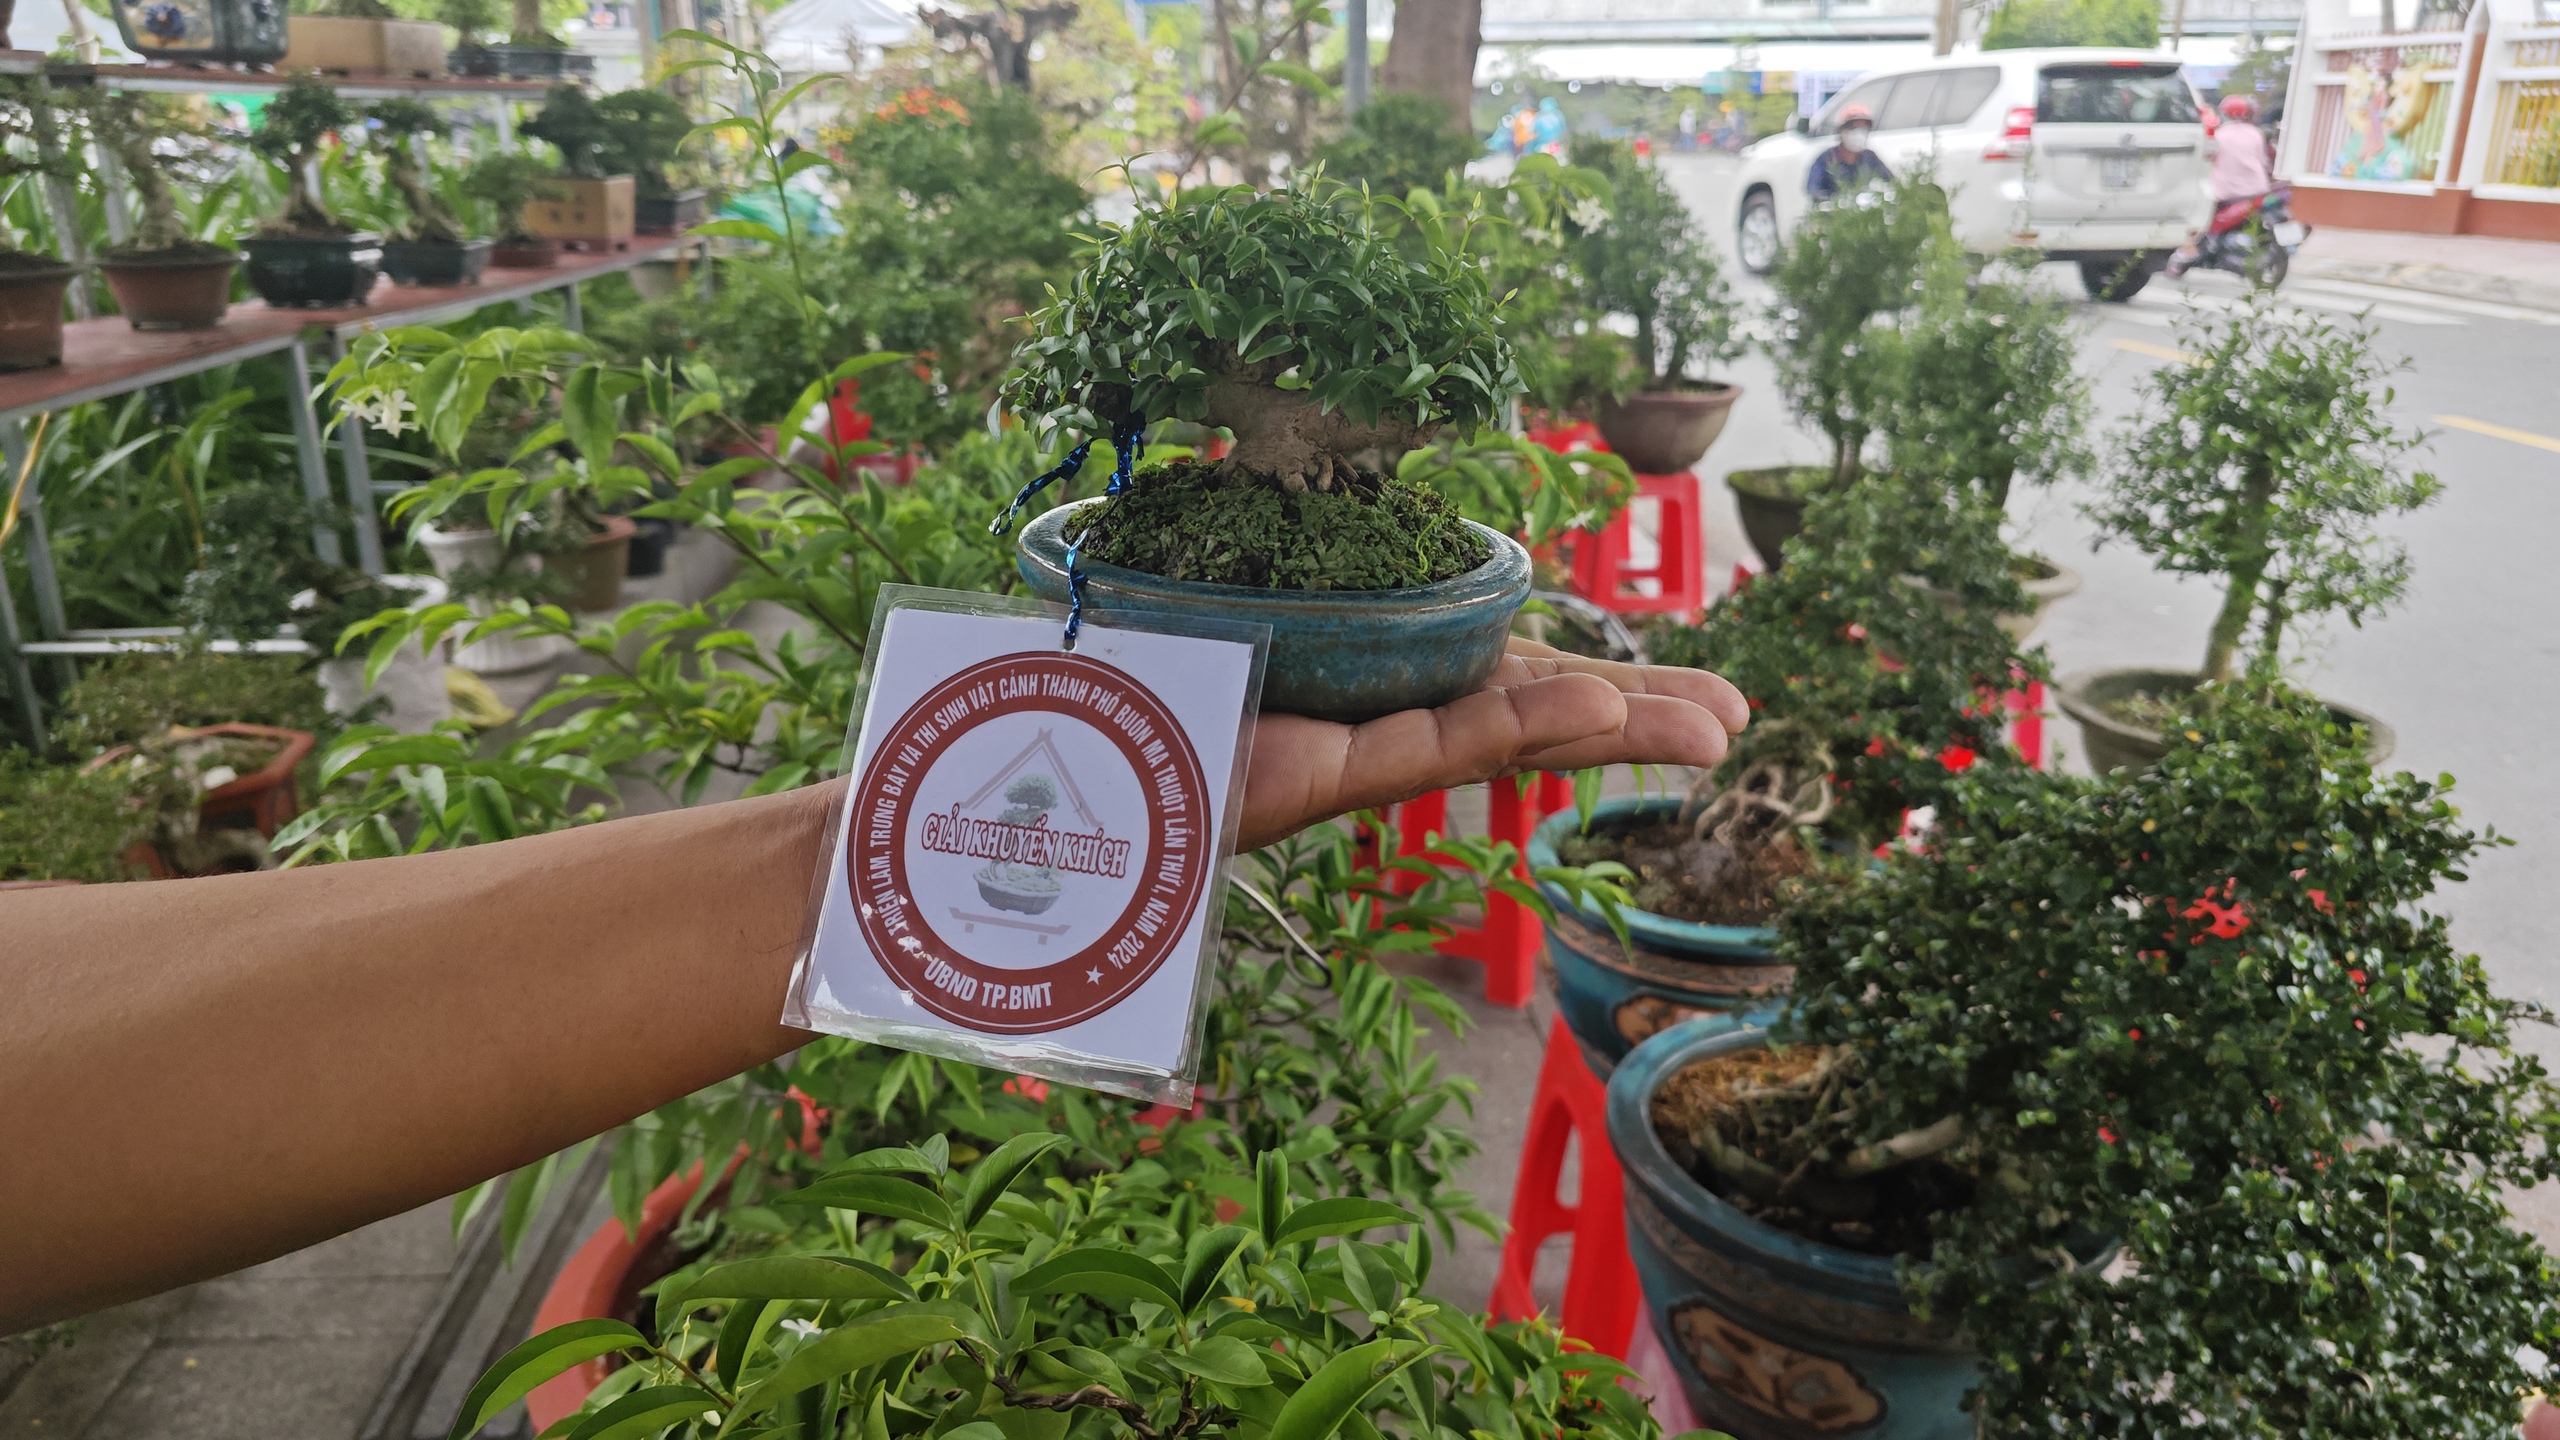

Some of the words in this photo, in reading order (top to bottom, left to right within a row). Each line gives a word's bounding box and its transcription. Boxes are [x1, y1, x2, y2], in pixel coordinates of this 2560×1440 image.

[967, 681, 996, 711] VẬT
[999, 669, 1038, 700] CẢNH
[1042, 671, 1091, 704] THÀNH
[1086, 685, 1126, 717] PHỐ
[934, 695, 970, 731] SINH
[1113, 703, 1154, 746] BUÔN
[913, 721, 940, 749] THI
[898, 742, 923, 767] VÀ
[1141, 738, 1170, 769] MA
[882, 763, 910, 796] BÀY
[1154, 763, 1189, 814] THUỘT
[870, 798, 898, 848] TRƯNG
[1164, 817, 1195, 850] LẦN
[921, 802, 970, 855] GIẢI
[967, 813, 1060, 868] KHUYẾN
[1057, 827, 1131, 879] KHÍCH
[1158, 853, 1187, 887] THỨ
[1134, 896, 1170, 938] NĂM
[1106, 930, 1145, 970] 2024
[924, 957, 978, 1002] UBND
[981, 981, 1052, 1010] TP.BMT
